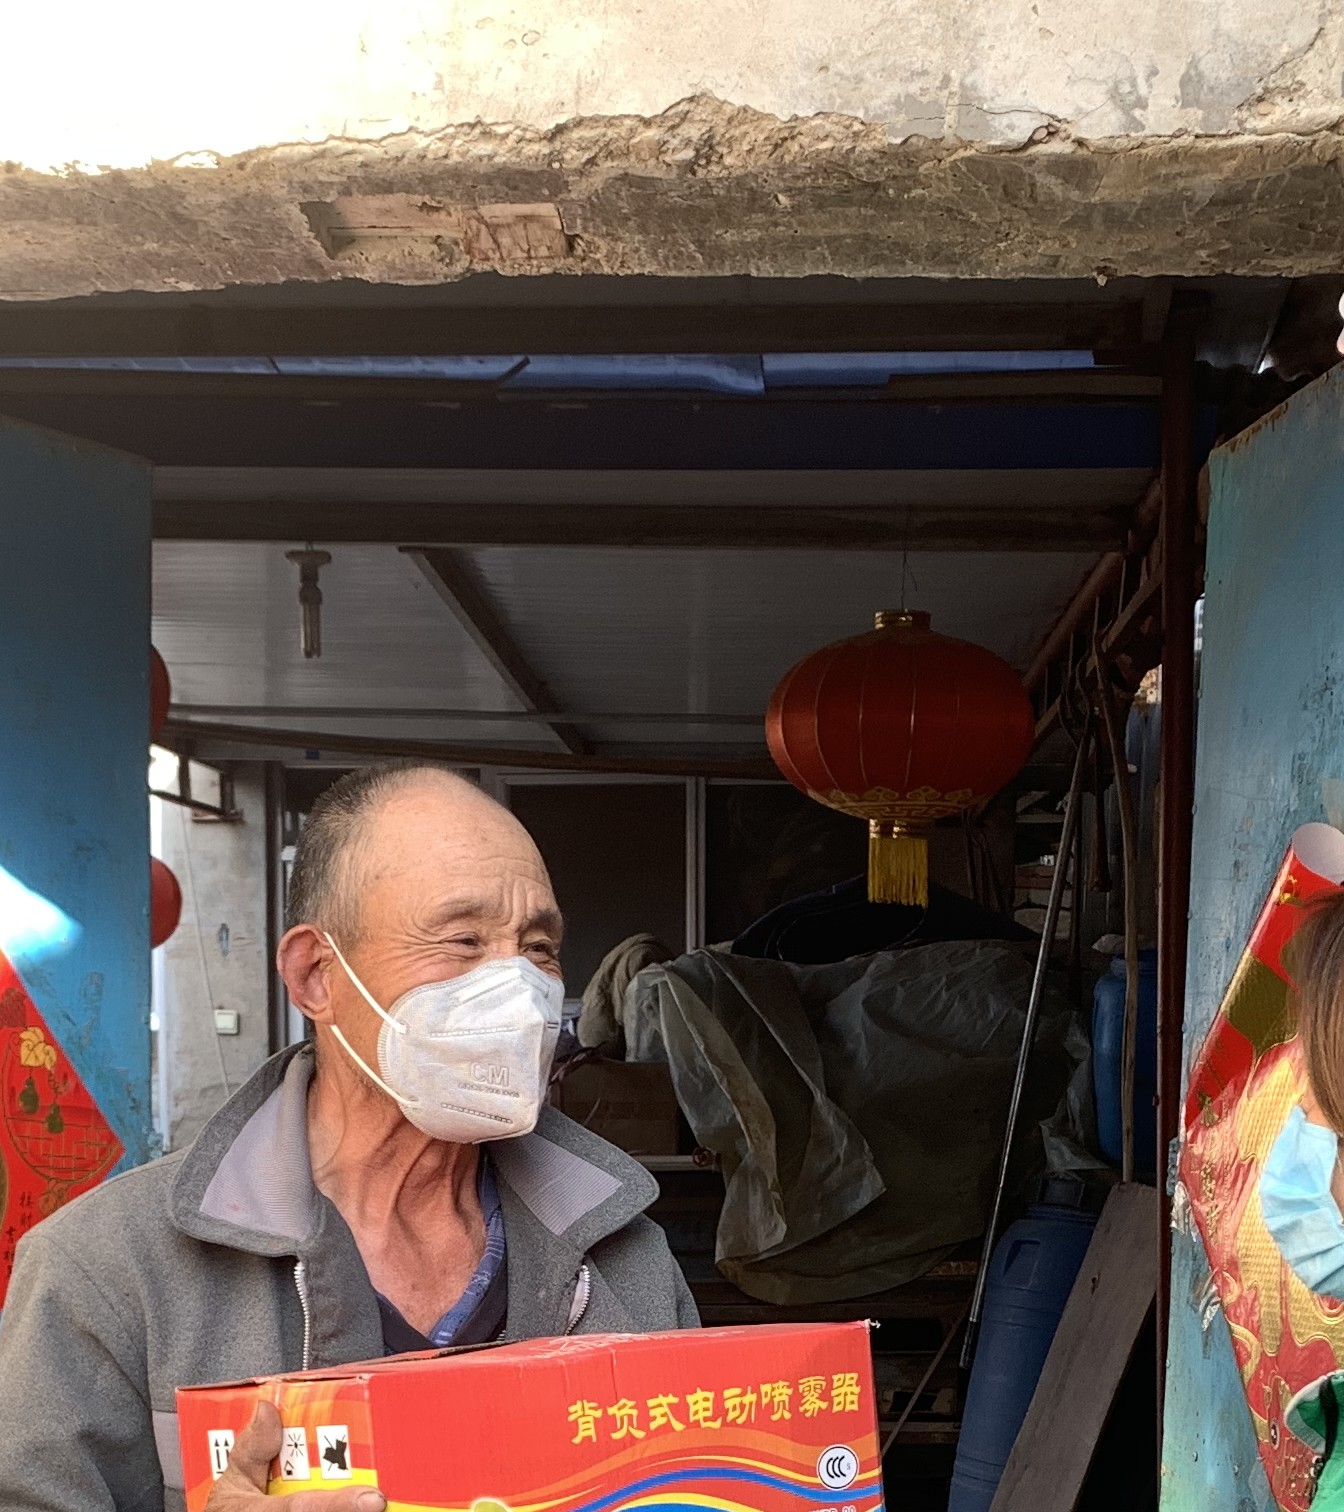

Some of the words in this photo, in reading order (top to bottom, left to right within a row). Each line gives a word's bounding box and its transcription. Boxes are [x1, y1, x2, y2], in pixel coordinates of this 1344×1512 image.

[471, 1062, 510, 1087] CM
[567, 1372, 861, 1444] 背负式电动喷雾器
